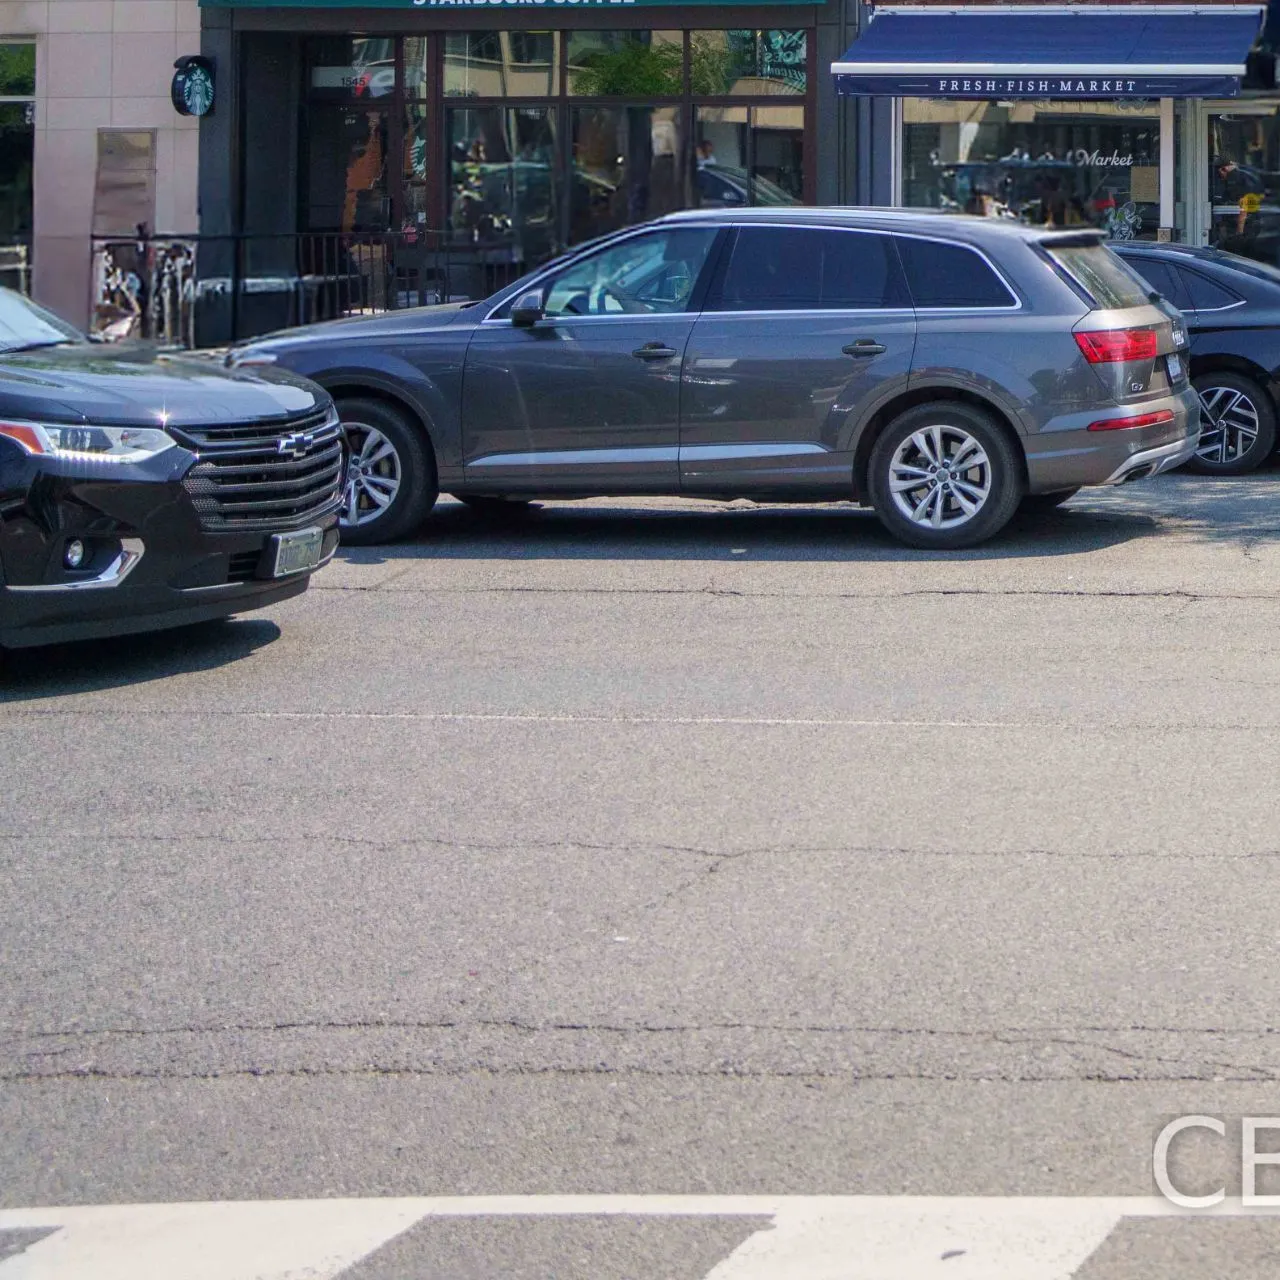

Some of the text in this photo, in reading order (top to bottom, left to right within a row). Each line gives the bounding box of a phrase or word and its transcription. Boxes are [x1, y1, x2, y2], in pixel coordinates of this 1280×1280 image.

[341, 76, 366, 87] 1545
[939, 80, 1136, 91] FRESH FISH MARKET
[1075, 148, 1135, 167] Market
